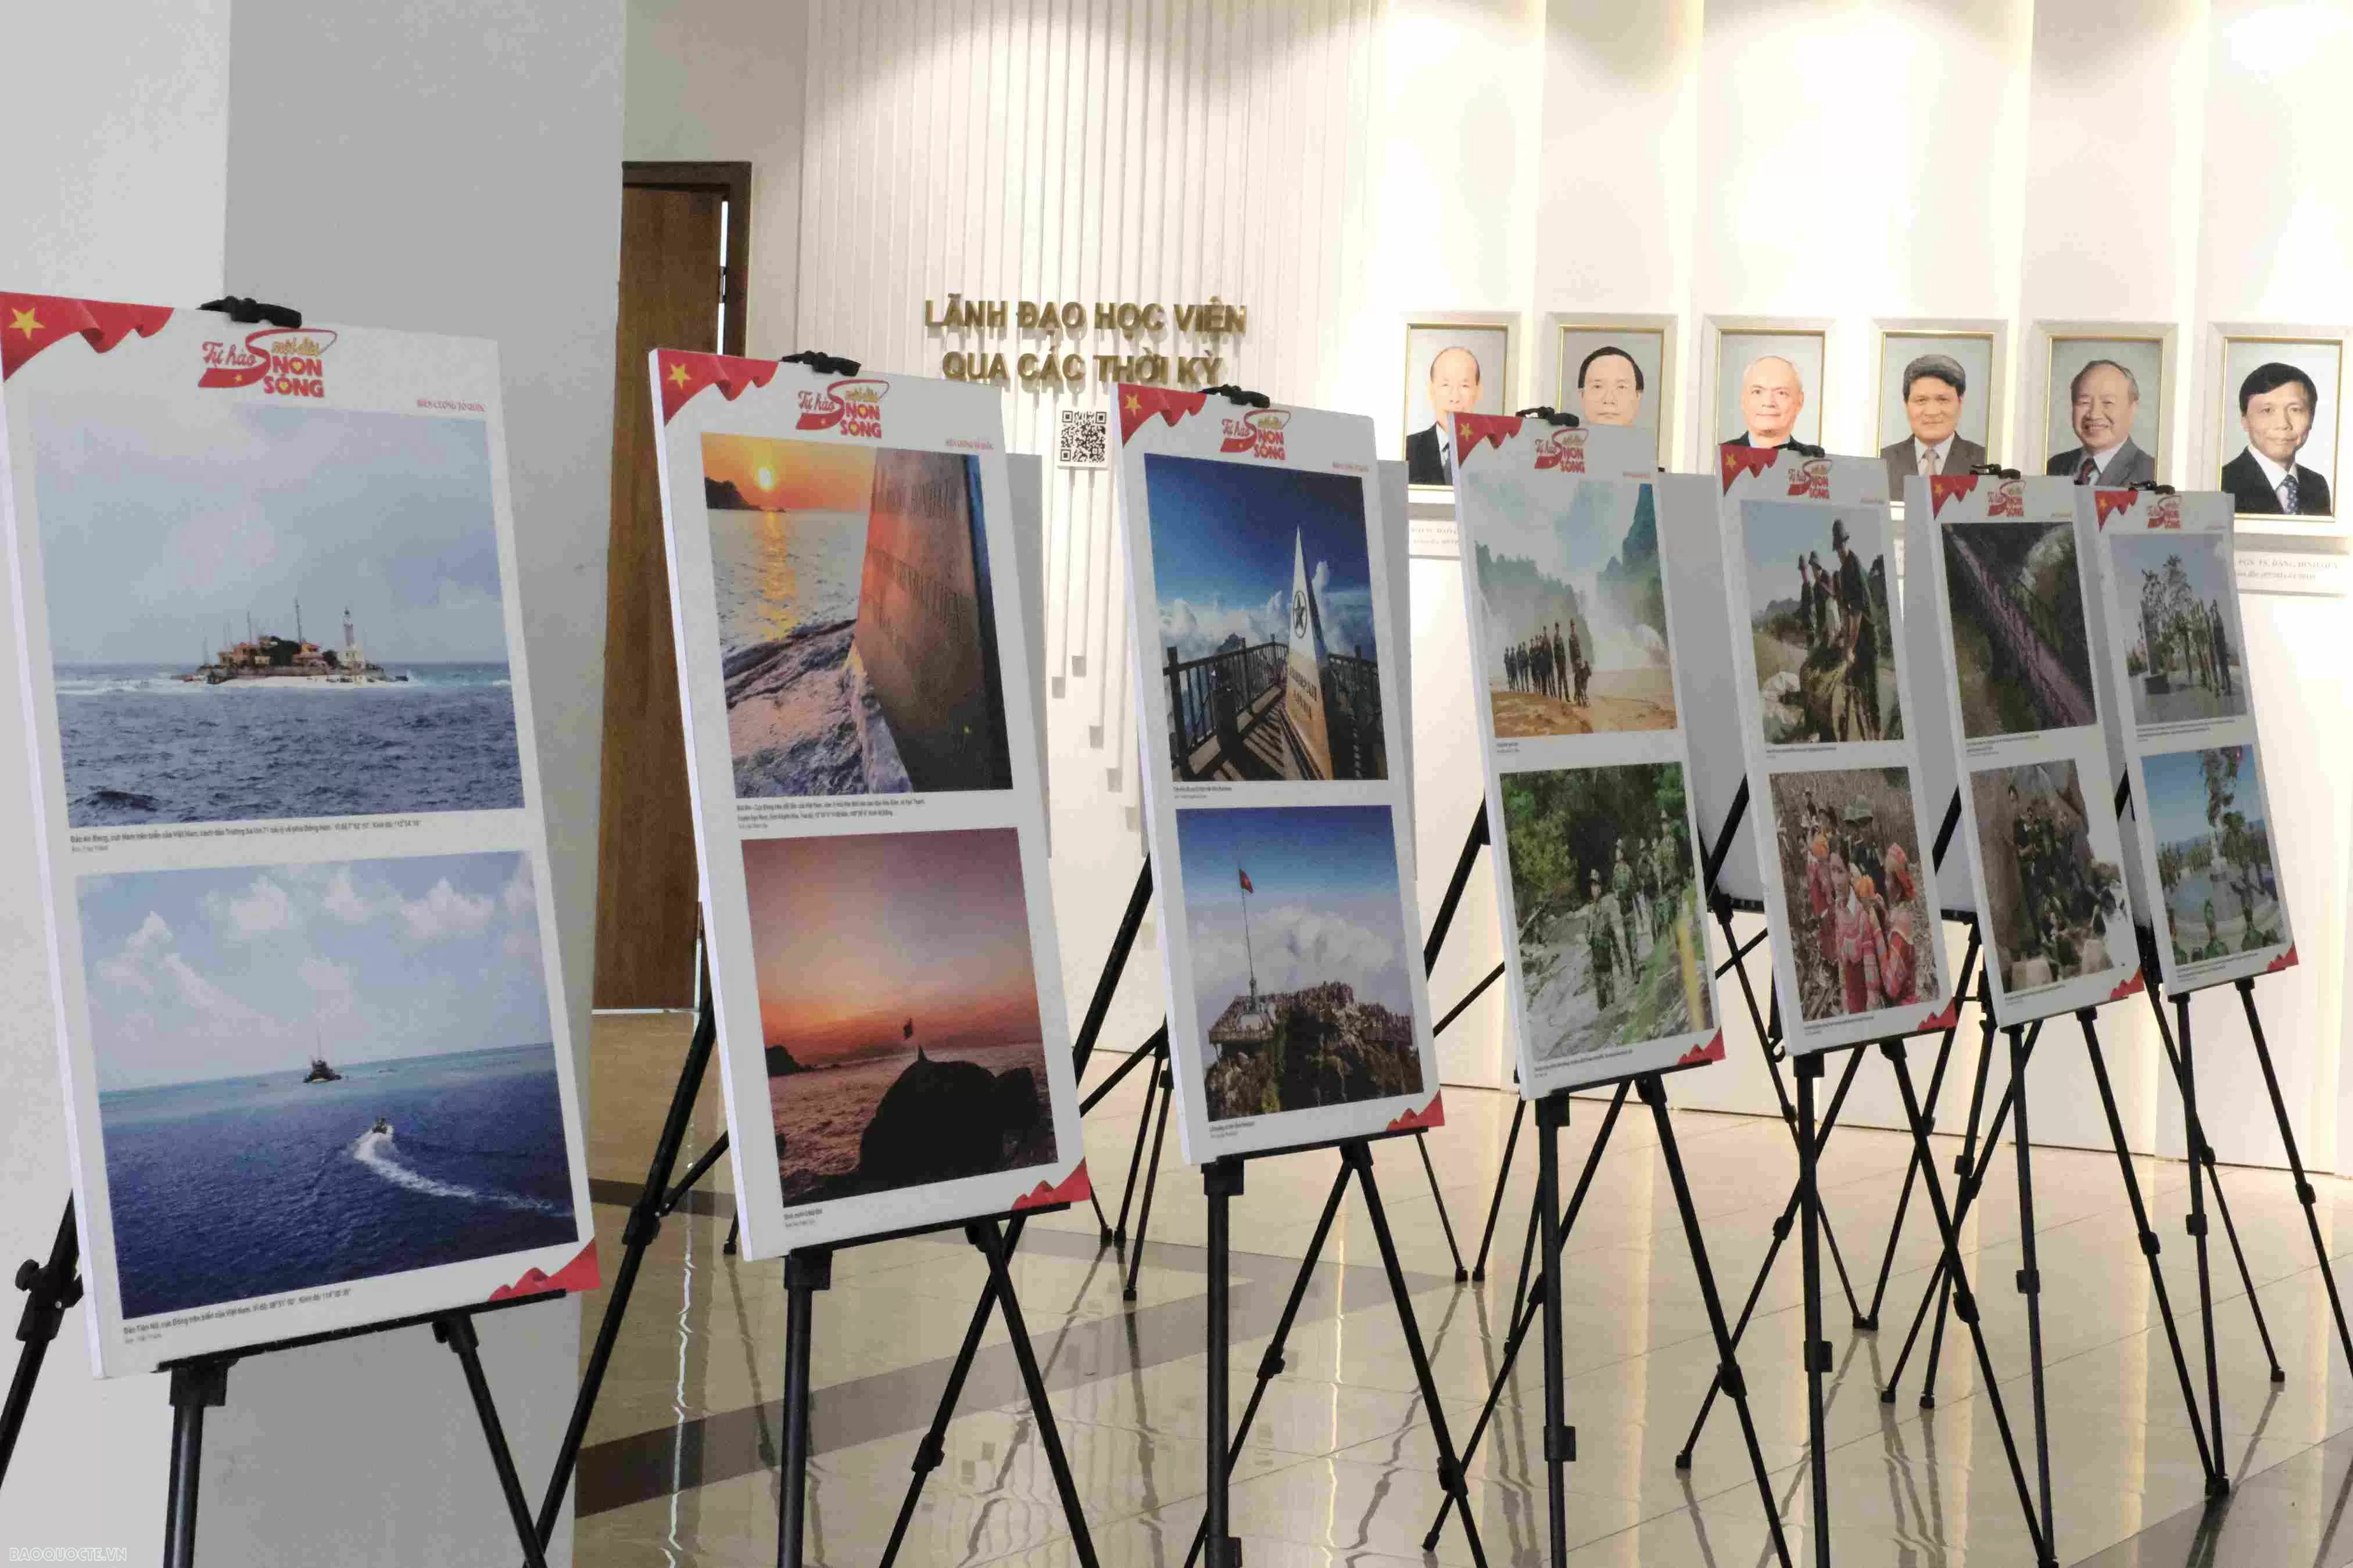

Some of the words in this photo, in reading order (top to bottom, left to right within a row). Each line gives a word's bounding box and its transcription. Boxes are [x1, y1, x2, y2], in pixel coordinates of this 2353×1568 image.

[925, 293, 1009, 327] LÃNH
[1016, 301, 1086, 336] ĐẠO
[1094, 303, 1167, 340] HỌC
[202, 341, 223, 367] Tự
[224, 344, 257, 366] hào
[943, 351, 1010, 382] QUA
[1018, 346, 1087, 381] CÁC
[1093, 347, 1169, 384] THỜI
[1178, 350, 1223, 385] KỲ
[271, 356, 323, 377] NON
[263, 373, 325, 398] SÔNG
[846, 403, 881, 421] NON
[840, 418, 882, 439] SÔNG
[1257, 429, 1284, 445] NON
